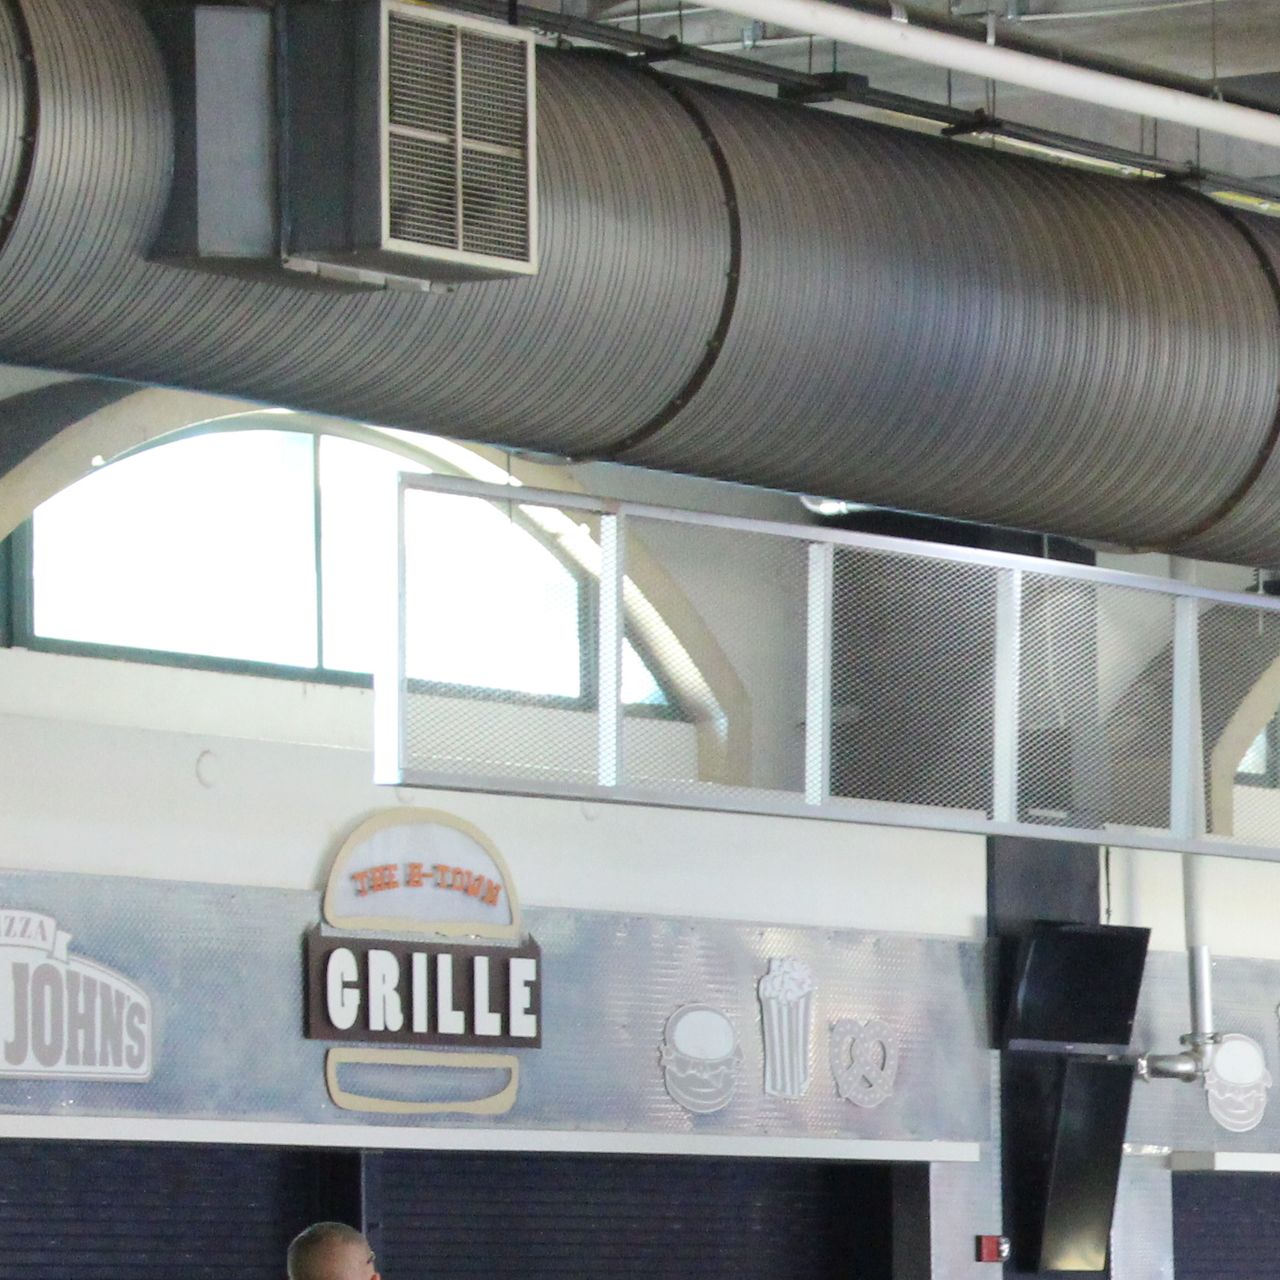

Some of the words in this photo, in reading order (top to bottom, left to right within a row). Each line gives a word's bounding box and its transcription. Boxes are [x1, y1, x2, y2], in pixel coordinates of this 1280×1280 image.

[351, 863, 400, 897] THE
[403, 861, 503, 907] H-TOWN
[0, 914, 48, 942] ZZA
[325, 946, 538, 1039] GRILLE
